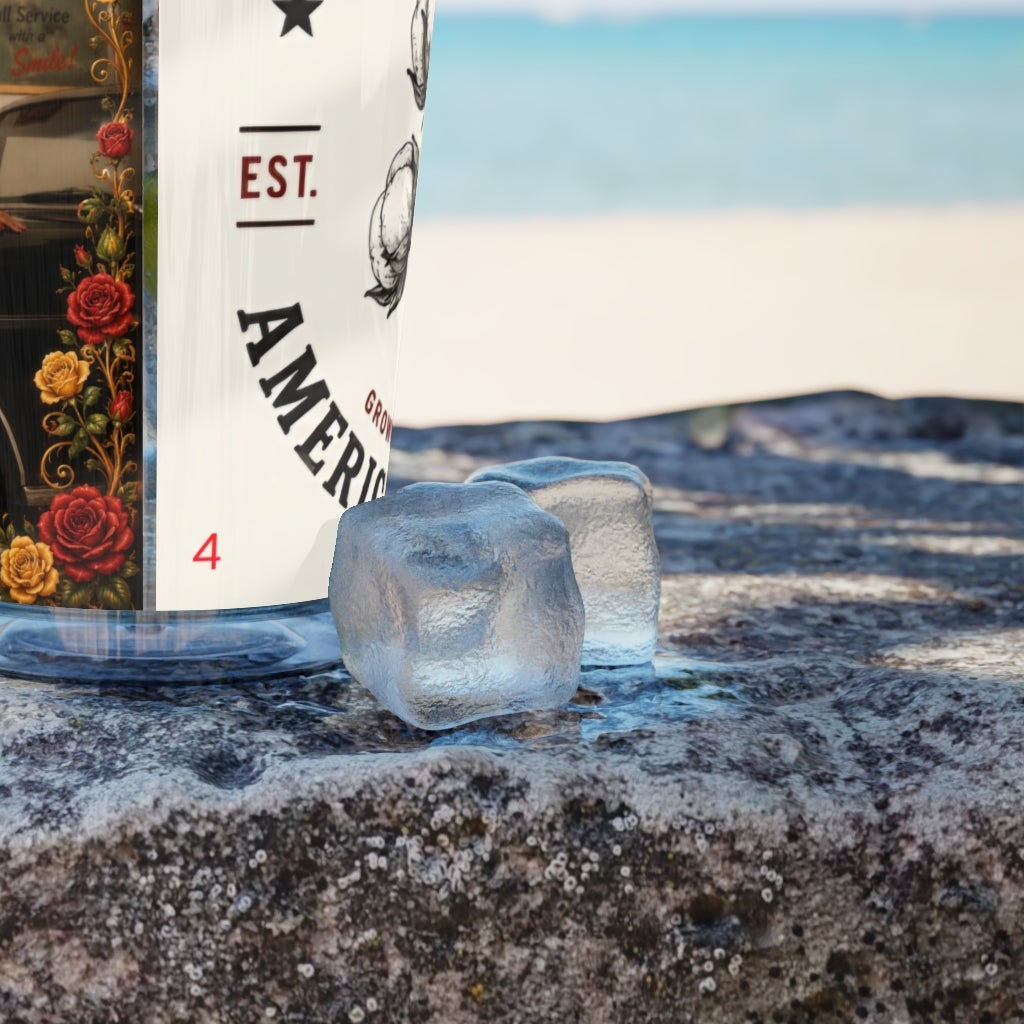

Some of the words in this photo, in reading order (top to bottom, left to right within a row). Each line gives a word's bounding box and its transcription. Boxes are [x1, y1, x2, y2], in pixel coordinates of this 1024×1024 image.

[17, 6, 70, 25] Service
[9, 28, 34, 43] with
[37, 33, 46, 43] a
[240, 154, 318, 199] EST.
[192, 532, 222, 571] 4
